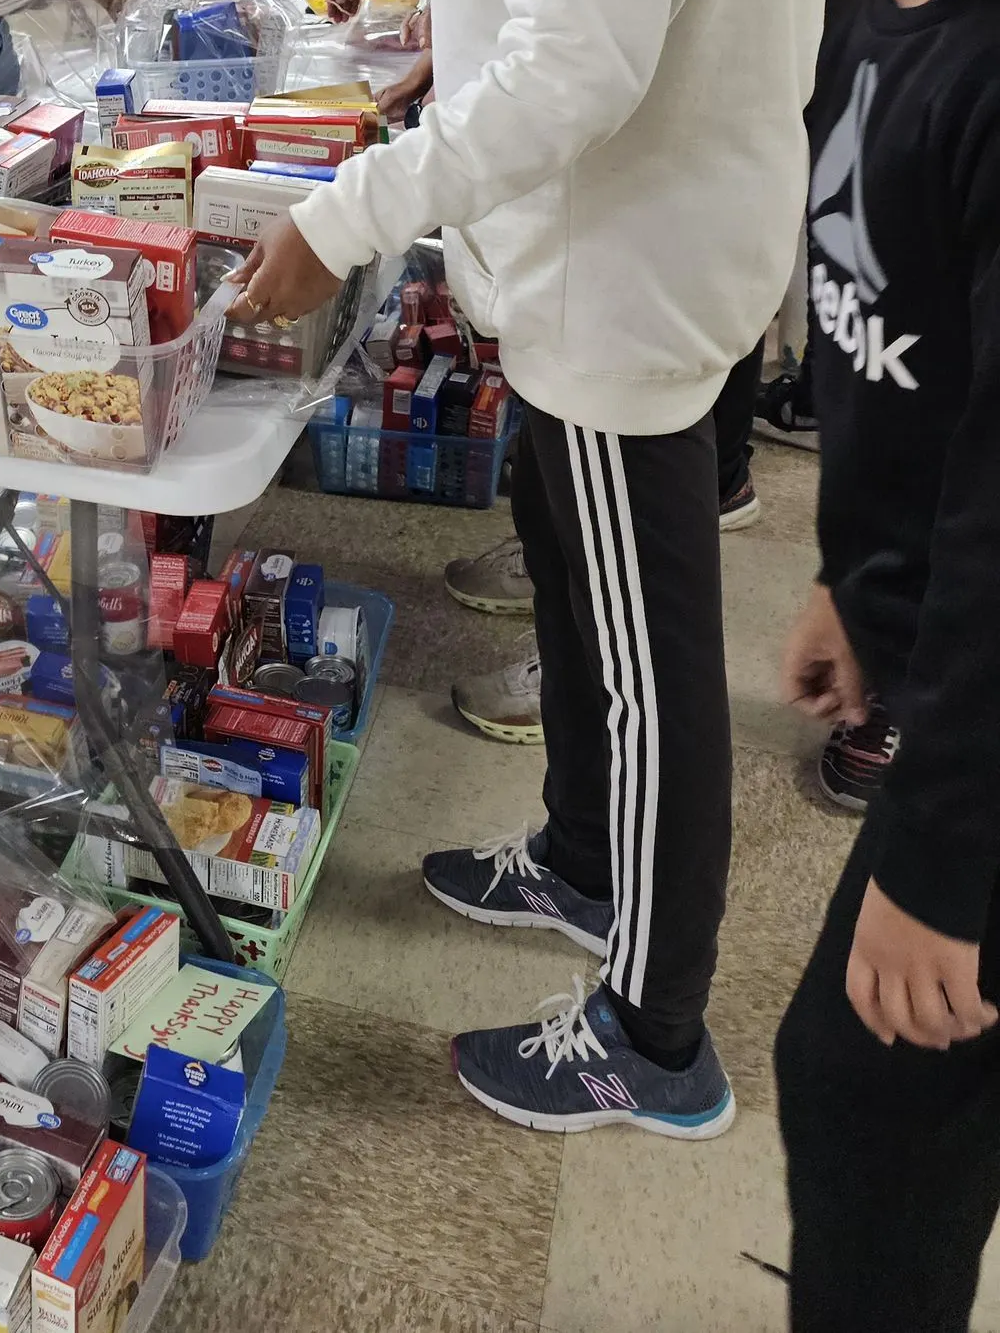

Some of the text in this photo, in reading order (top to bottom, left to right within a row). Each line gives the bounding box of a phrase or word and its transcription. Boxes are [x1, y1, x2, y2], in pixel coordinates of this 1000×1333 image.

[77, 167, 120, 181] IDAHOAN
[68, 257, 105, 267] Turkey
[9, 307, 41, 321] Great
[17, 316, 42, 326] Value
[99, 597, 123, 612] bell's
[264, 818, 282, 849] HOMEMADE
[31, 901, 51, 921] Turkey
[196, 987, 260, 1036] Happy
[577, 1072, 639, 1110] N
[86, 1275, 113, 1330] Super
[111, 1228, 137, 1272] Moist
